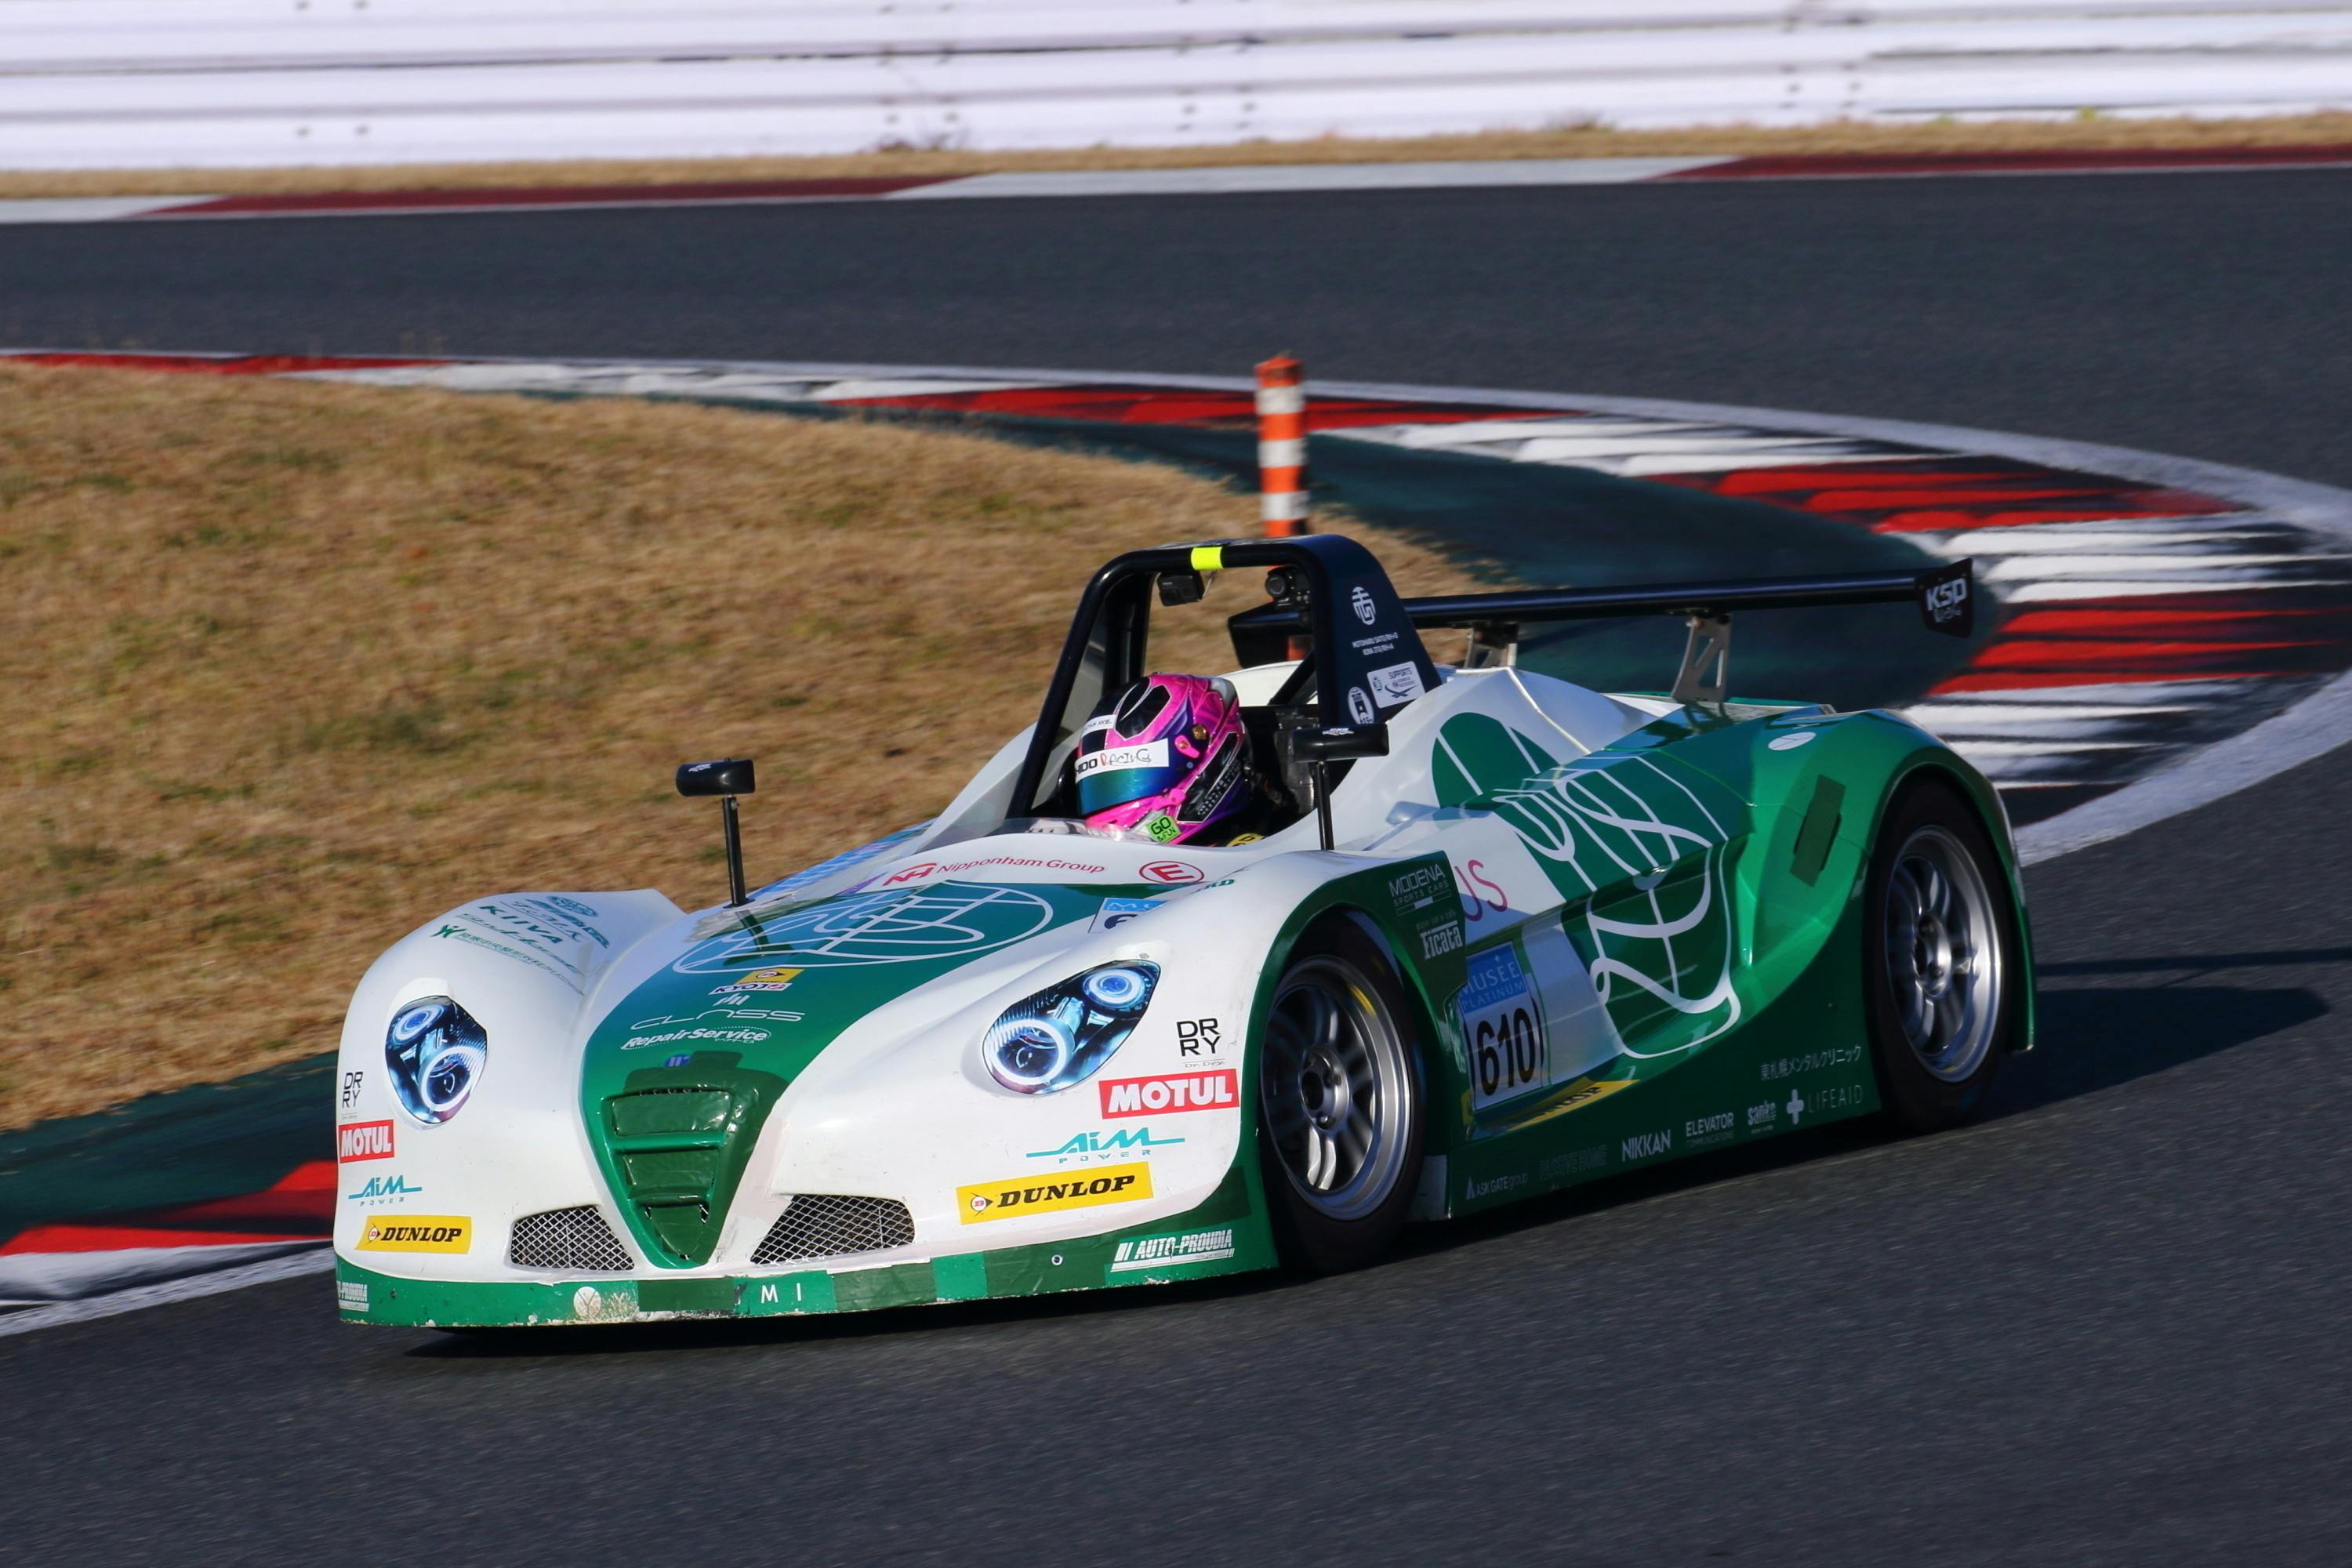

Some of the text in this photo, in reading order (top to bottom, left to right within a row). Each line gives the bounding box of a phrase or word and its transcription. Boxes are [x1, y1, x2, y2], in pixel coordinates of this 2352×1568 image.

[1151, 817, 1171, 836] GO
[937, 856, 1105, 874] Nipponham Group
[1388, 863, 1446, 898] MODENA
[1393, 879, 1450, 908] SPORTS CARS
[1461, 980, 1524, 1010] PLATINUM
[1177, 1018, 1221, 1039] DR
[1179, 1035, 1221, 1057] RY
[1476, 1007, 1536, 1097] 610
[343, 1071, 363, 1090] DR
[1107, 1075, 1233, 1113] MOTUL
[342, 1090, 361, 1109] RY
[1807, 1084, 1864, 1113] LIFEAID
[1686, 1112, 1734, 1138] ELEVATOR
[340, 1125, 392, 1158] MOTUL
[1621, 1129, 1671, 1162] NIKKAN
[1058, 1149, 1152, 1163] POWER
[360, 1196, 405, 1207] POWER
[997, 1174, 1134, 1209] DUNLOP
[381, 1227, 463, 1243] DUNLOP
[1134, 1229, 1232, 1260] AUTO-PROUDIA
